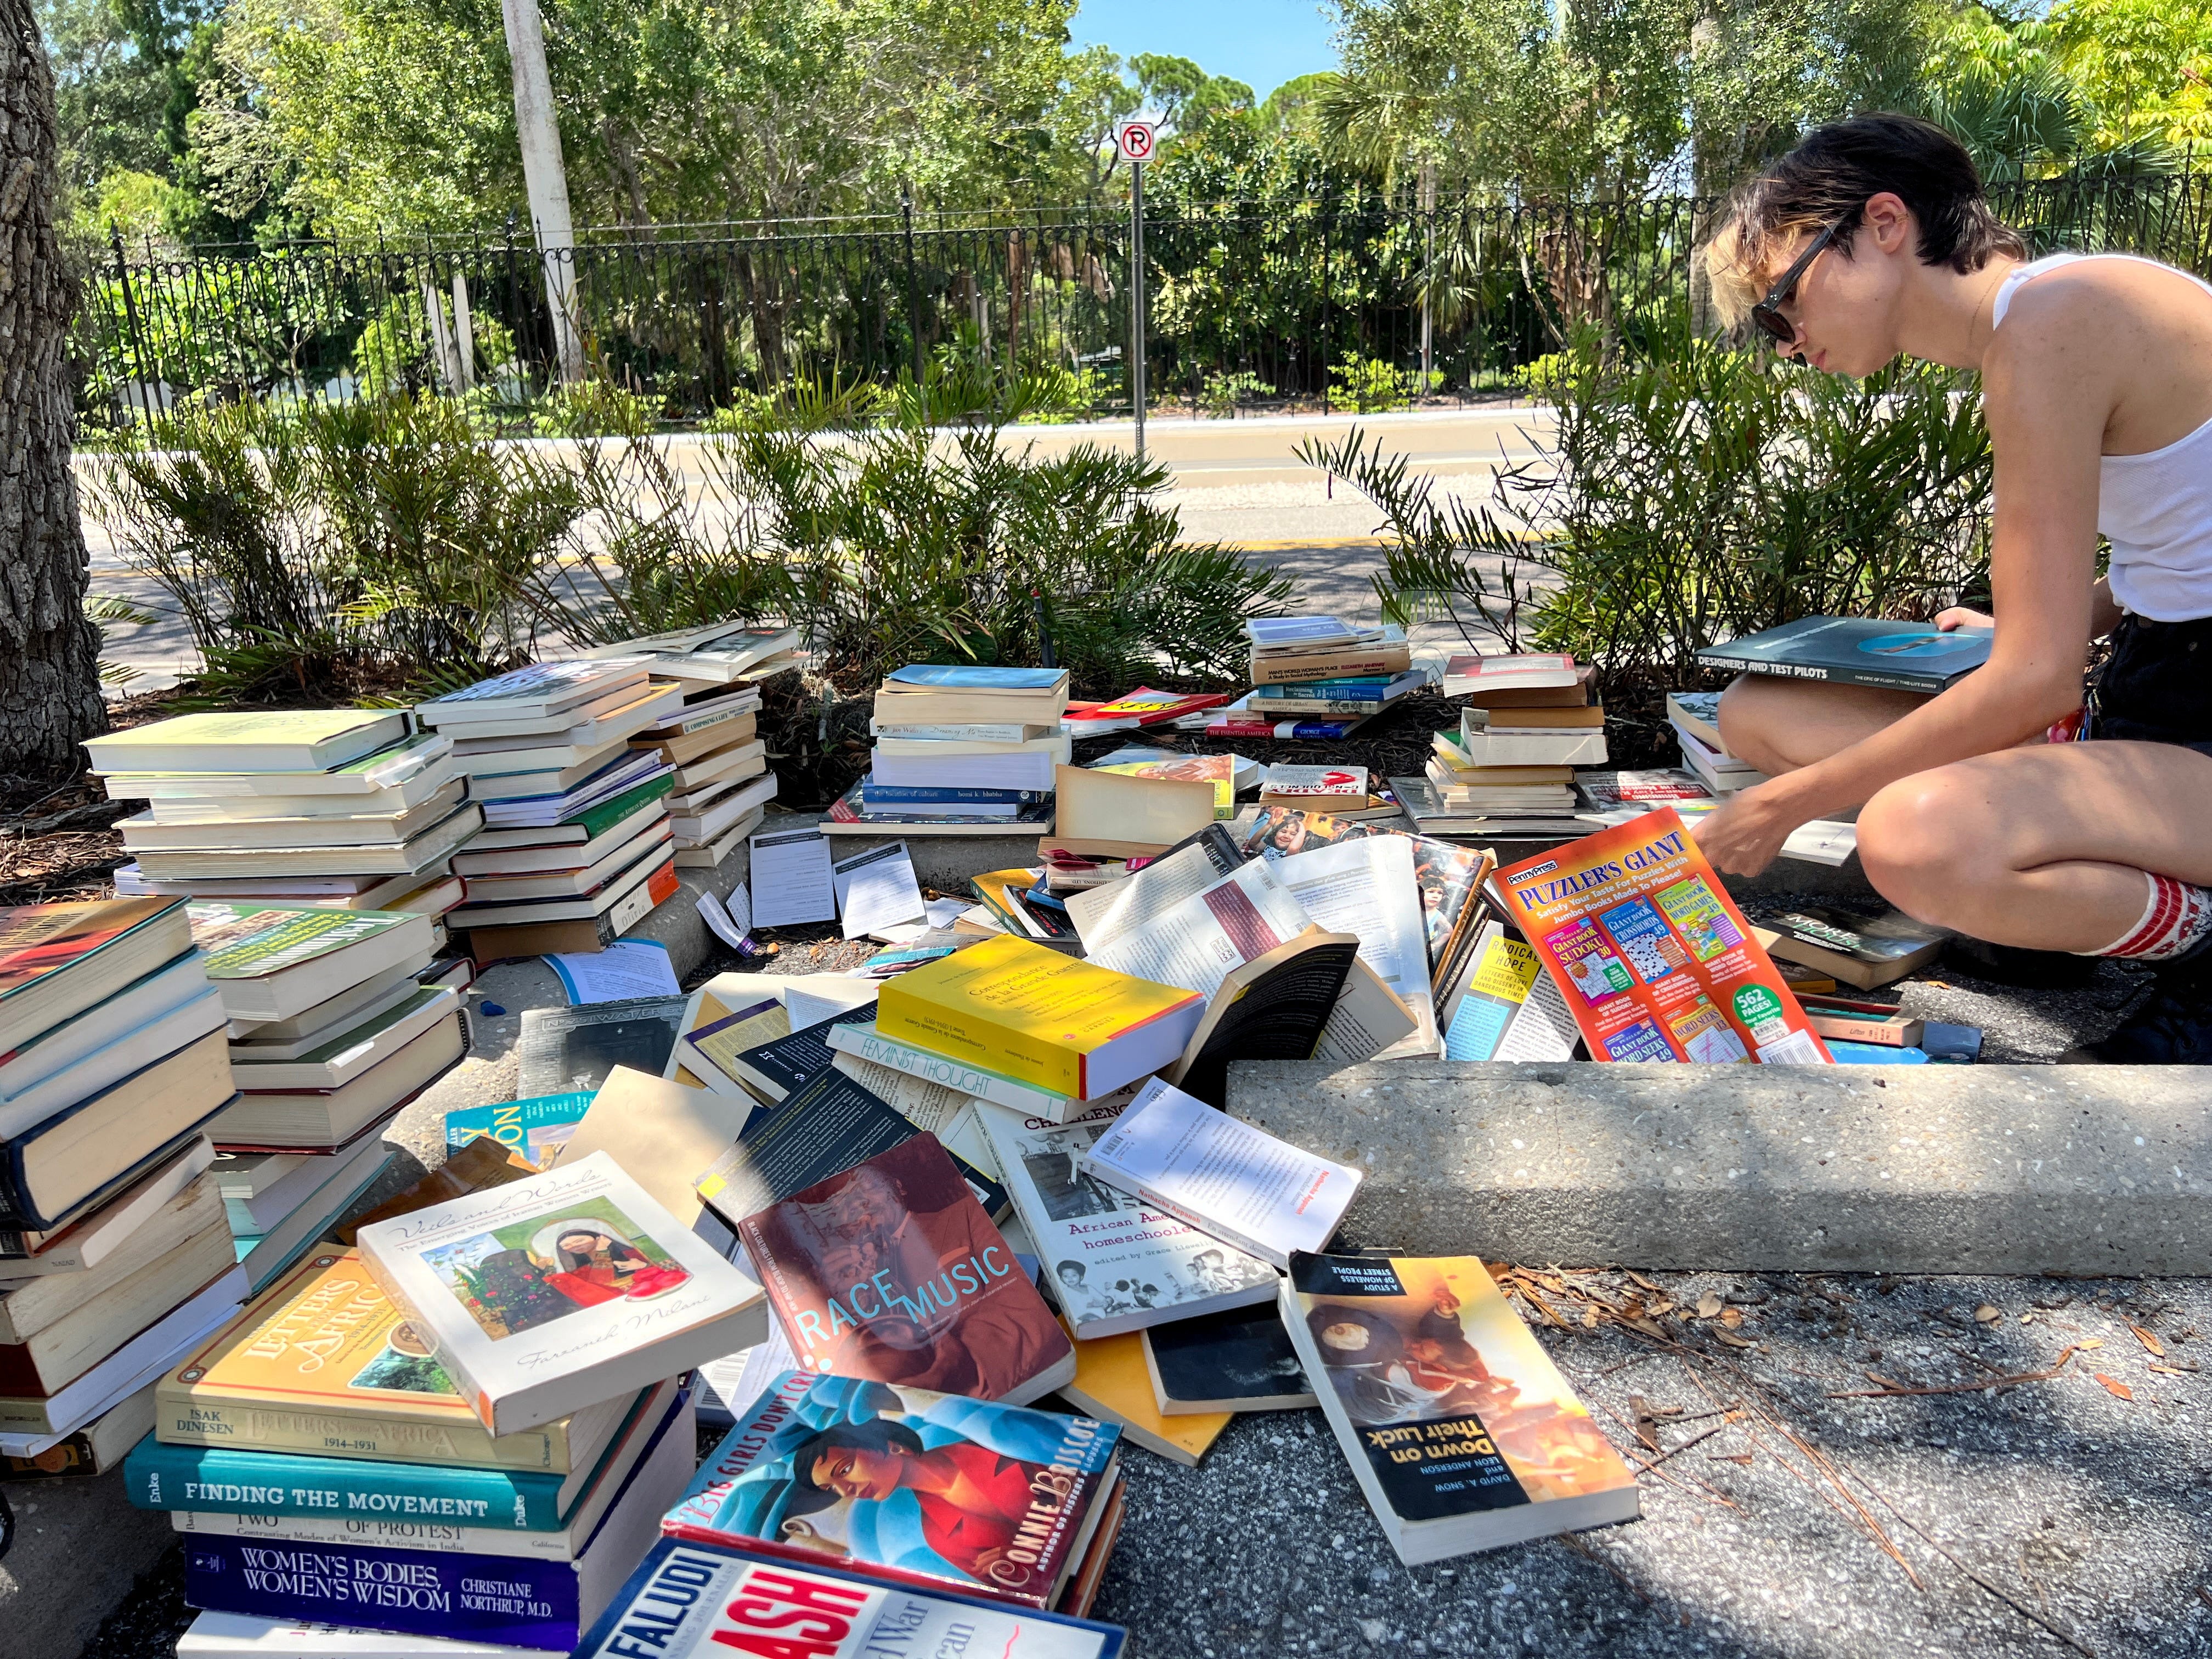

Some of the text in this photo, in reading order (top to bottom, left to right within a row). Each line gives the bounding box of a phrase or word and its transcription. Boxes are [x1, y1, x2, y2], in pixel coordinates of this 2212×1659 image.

[1697, 656, 1828, 680] DESIGNERS AND TEST PILOTS
[617, 795, 651, 821] THE AFRICAN QUEEN
[1509, 861, 1557, 885] PennyPress
[1516, 830, 1687, 912] PUZZLER'S GIANT
[1536, 856, 1689, 919] Satisfy Your Taste For Puzzles With
[1553, 868, 1683, 924] Jumbo Books Made To Please!
[1663, 884, 1707, 911] GIANT BOOK
[621, 904, 647, 928] Olivia
[1608, 905, 1653, 932] GIANT BOOK
[1669, 893, 1714, 921] WORD GAMES
[1708, 902, 1720, 914] 49
[1552, 926, 1599, 953] GIANT BOOK
[1614, 914, 1660, 943] CROSSWORDS
[1654, 924, 1666, 936] 49
[1491, 940, 1540, 963] RADICAL
[1559, 936, 1605, 964] SUDOKU
[1598, 945, 1612, 958] 30
[1704, 957, 1722, 969] GIANT
[1722, 952, 1735, 962] BOOK
[1496, 955, 1527, 972] HOPE
[1709, 962, 1726, 973] WORD
[1726, 955, 1746, 966] GAMES
[969, 964, 1048, 997] Correspondance
[985, 993, 1000, 1002] de
[1009, 975, 1047, 993] Grande
[1047, 961, 1084, 977] Guerre
[1480, 974, 1492, 983] AND
[1493, 978, 1517, 990] DISSENT
[1481, 968, 1504, 979] LETTERS
[1514, 977, 1528, 987] LOVE
[1654, 973, 1687, 989] GIANT BOOK
[1474, 980, 1525, 1000] DANGEROUS TIMES
[1736, 988, 1766, 1009] 562
[1598, 995, 1632, 1013] GIANT BOOK
[1611, 1001, 1633, 1014] SUDOKU
[1741, 1000, 1773, 1018] PAGES!
[1745, 1006, 1781, 1025] Your Favorite
[1673, 1008, 1720, 1038] WORD SEEKS
[1716, 1019, 1727, 1031] 13
[1849, 1028, 1865, 1036] Lifton
[1610, 1026, 1660, 1058] GIANT BOOK
[1641, 1037, 1666, 1057] SEEKS
[1658, 1048, 1673, 1061] 49
[860, 1037, 919, 1070] FEMINIST
[921, 1057, 993, 1097] THOUGHT
[420, 1182, 613, 1246] Emerging Voices Iranian Women Writers
[1138, 1188, 1201, 1224] Nathacha Appanah
[1068, 1217, 1134, 1236] African
[1207, 1222, 1274, 1261] En attendant demain
[1094, 1254, 1127, 1266] edited
[1128, 1251, 1141, 1261] by
[1145, 1246, 1172, 1257] Grace
[1331, 1266, 1391, 1276] STREET PEOPLE
[1340, 1275, 1395, 1284] OF HOMELESS
[897, 1245, 1010, 1324] MUSIC
[1364, 1283, 1391, 1291] STUDY
[243, 1278, 361, 1361] LETTERS
[794, 1268, 902, 1350] RACE
[293, 1283, 386, 1374] AFRIC
[176, 1419, 234, 1436] DINESEN
[189, 1408, 221, 1423] ISAK
[245, 1411, 461, 1458] LETTERS AFRICA
[1365, 1419, 1485, 1450] Their Luck
[542, 1433, 550, 1469] Chicago
[678, 1369, 817, 1525] BIG GIRLS DON'T CRY
[1389, 1437, 1496, 1465] Down on
[1420, 1457, 1500, 1475] LEON ANDERSON
[148, 1473, 162, 1505] Enke
[1435, 1473, 1511, 1493] DAVID A. SNOW
[184, 1482, 489, 1519] FINDING THE MOVEMENT
[515, 1494, 527, 1528] Duke
[990, 1417, 1101, 1589] CONNIE BRISCOE
[236, 1527, 465, 1551] Contrasting Modes of Women's Activism in India
[346, 1520, 370, 1534] OF
[376, 1521, 466, 1541] PROTEST
[241, 1547, 441, 1590] WOMEN'S BODIES,
[242, 1568, 450, 1613] WOMEN'S WISDOM
[460, 1577, 532, 1599] CHRISTIANE
[460, 1594, 552, 1618] NORTHRUP, M.D.
[605, 1553, 723, 1659] FALUDI
[710, 1569, 872, 1659] ASH
